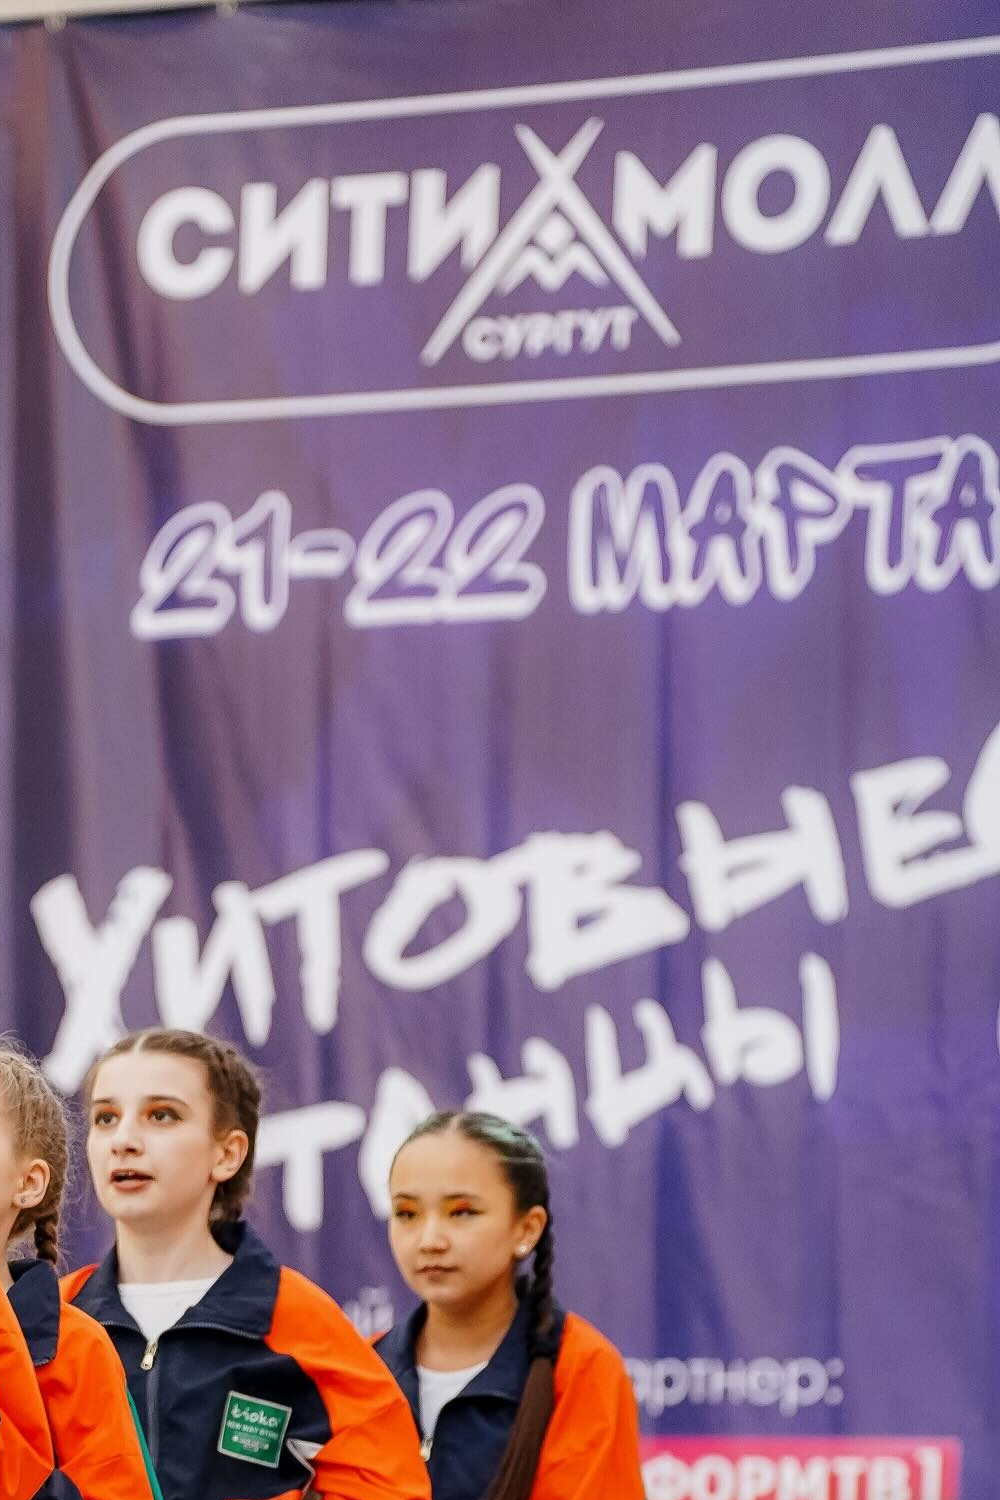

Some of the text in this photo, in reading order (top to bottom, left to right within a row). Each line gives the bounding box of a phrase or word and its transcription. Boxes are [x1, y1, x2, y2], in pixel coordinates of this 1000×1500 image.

[136, 161, 503, 300] СИТИ
[461, 304, 639, 364] СУРГУТ
[129, 432, 1000, 641] 21-22 МАРТА
